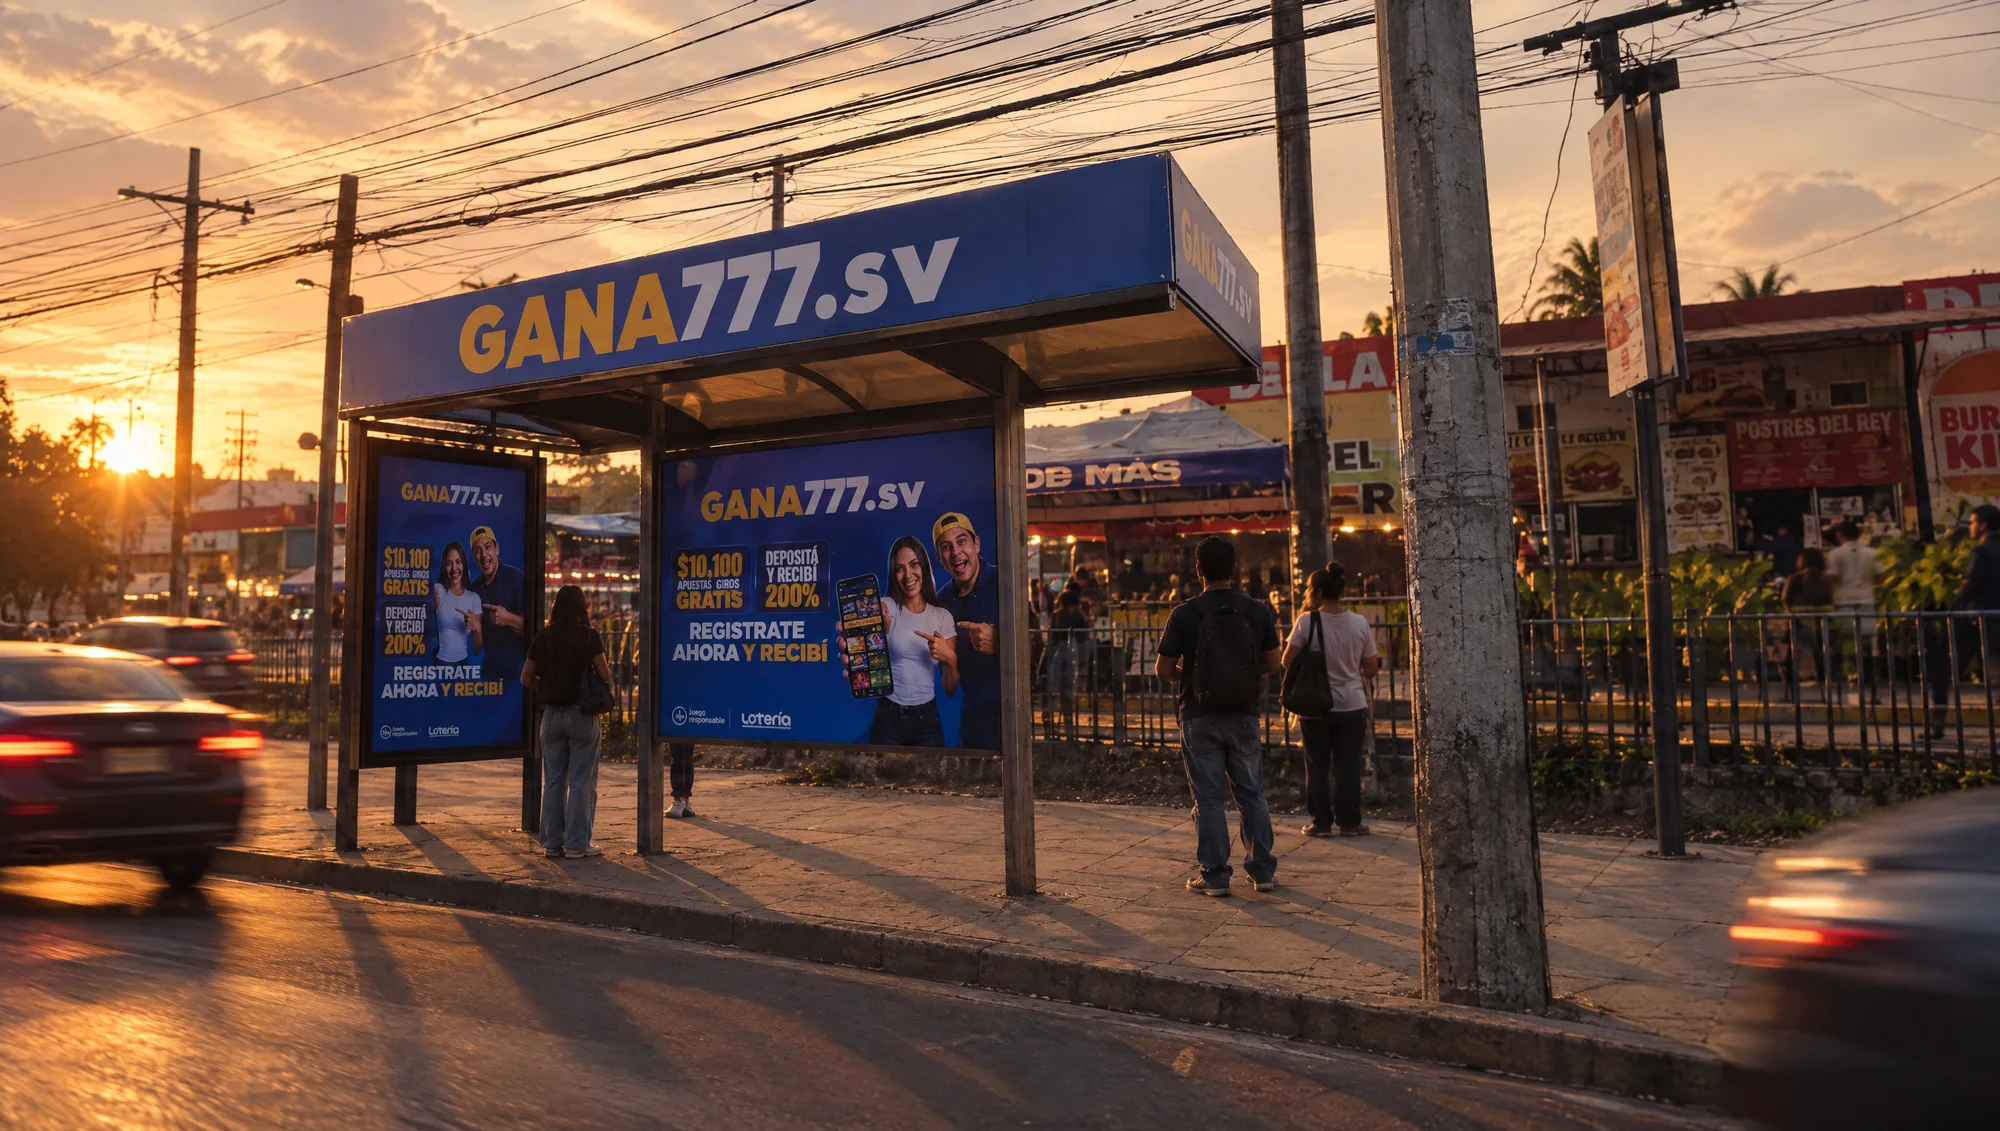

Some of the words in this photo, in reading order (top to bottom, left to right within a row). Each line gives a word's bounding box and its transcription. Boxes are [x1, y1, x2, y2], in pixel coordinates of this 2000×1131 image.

[459, 237, 960, 373] GANA777.sv
[1735, 417, 1816, 440] POSTRES
[1819, 413, 1853, 435] DEL
[1857, 412, 1893, 433] REY
[1945, 432, 2000, 470] KI
[401, 481, 503, 507] GANA777.sv
[700, 476, 926, 523] GANA777.sv
[765, 545, 819, 566] DEPOSITÁ
[766, 567, 776, 583] Y
[777, 564, 818, 583] RECIBÍ
[383, 578, 430, 596] GRATIS
[716, 578, 740, 590] GIROS
[676, 590, 743, 610] GRATIS
[765, 583, 820, 608] 200%
[385, 603, 427, 620] DEPOSITÁ
[386, 620, 394, 634] Y
[395, 619, 425, 634] RECIBÍ
[690, 620, 805, 640] REGISTRATE
[384, 634, 426, 655] 200%
[672, 643, 740, 662] AHORA
[742, 643, 756, 662] Y
[760, 638, 828, 662] RECIBÍ
[394, 665, 481, 681] REGISTRATE
[381, 682, 439, 699] AHORA
[441, 682, 452, 697] Y
[454, 677, 503, 697] RECIBÍ
[689, 716, 726, 725] responsable
[742, 711, 791, 726] Lotería
[428, 724, 460, 735] Lotería
